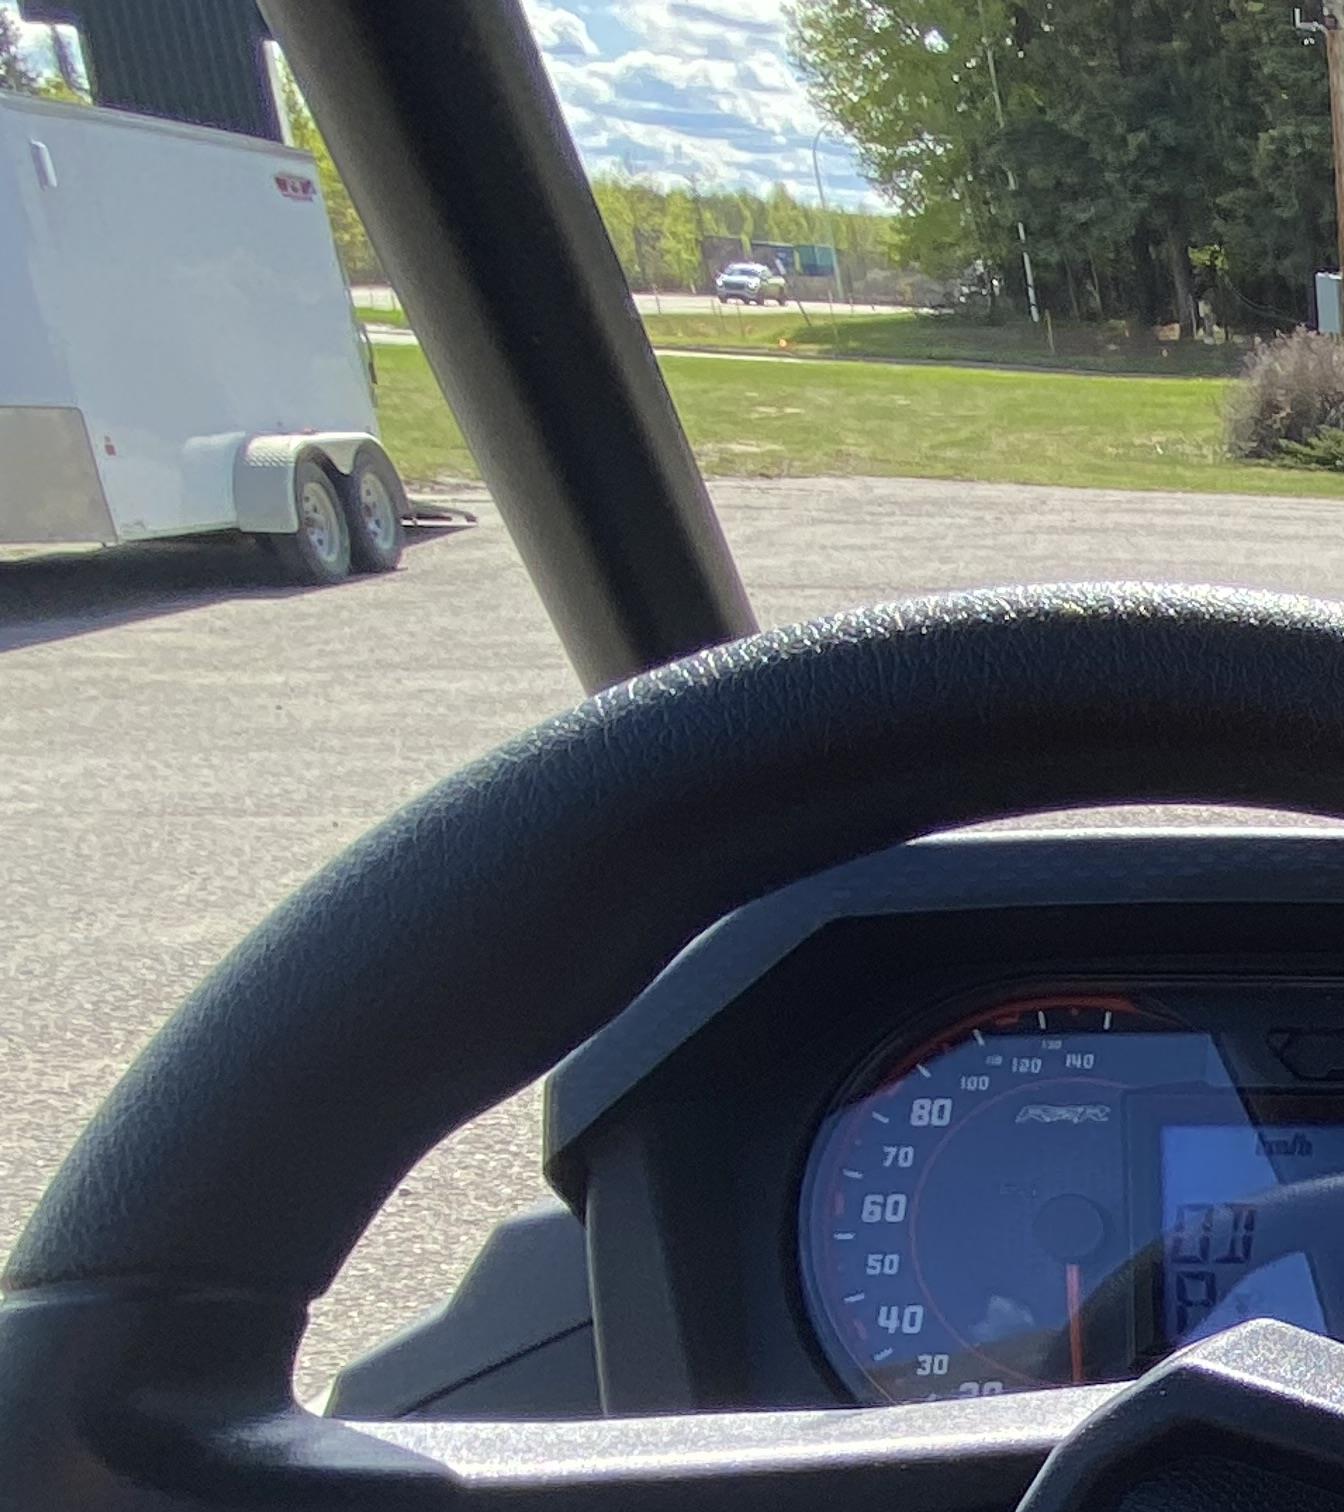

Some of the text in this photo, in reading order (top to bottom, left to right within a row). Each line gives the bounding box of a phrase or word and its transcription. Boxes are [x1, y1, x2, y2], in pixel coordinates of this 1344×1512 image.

[1011, 1057, 1042, 1074] 120
[1065, 1053, 1095, 1070] 140
[960, 1076, 990, 1091] 100
[910, 1098, 952, 1126] 80
[882, 1146, 914, 1168] 70
[861, 1194, 907, 1222] 60
[866, 1253, 899, 1276] 50
[1176, 1271, 1217, 1333] P
[877, 1304, 924, 1334] 40
[917, 1355, 949, 1376] 30
